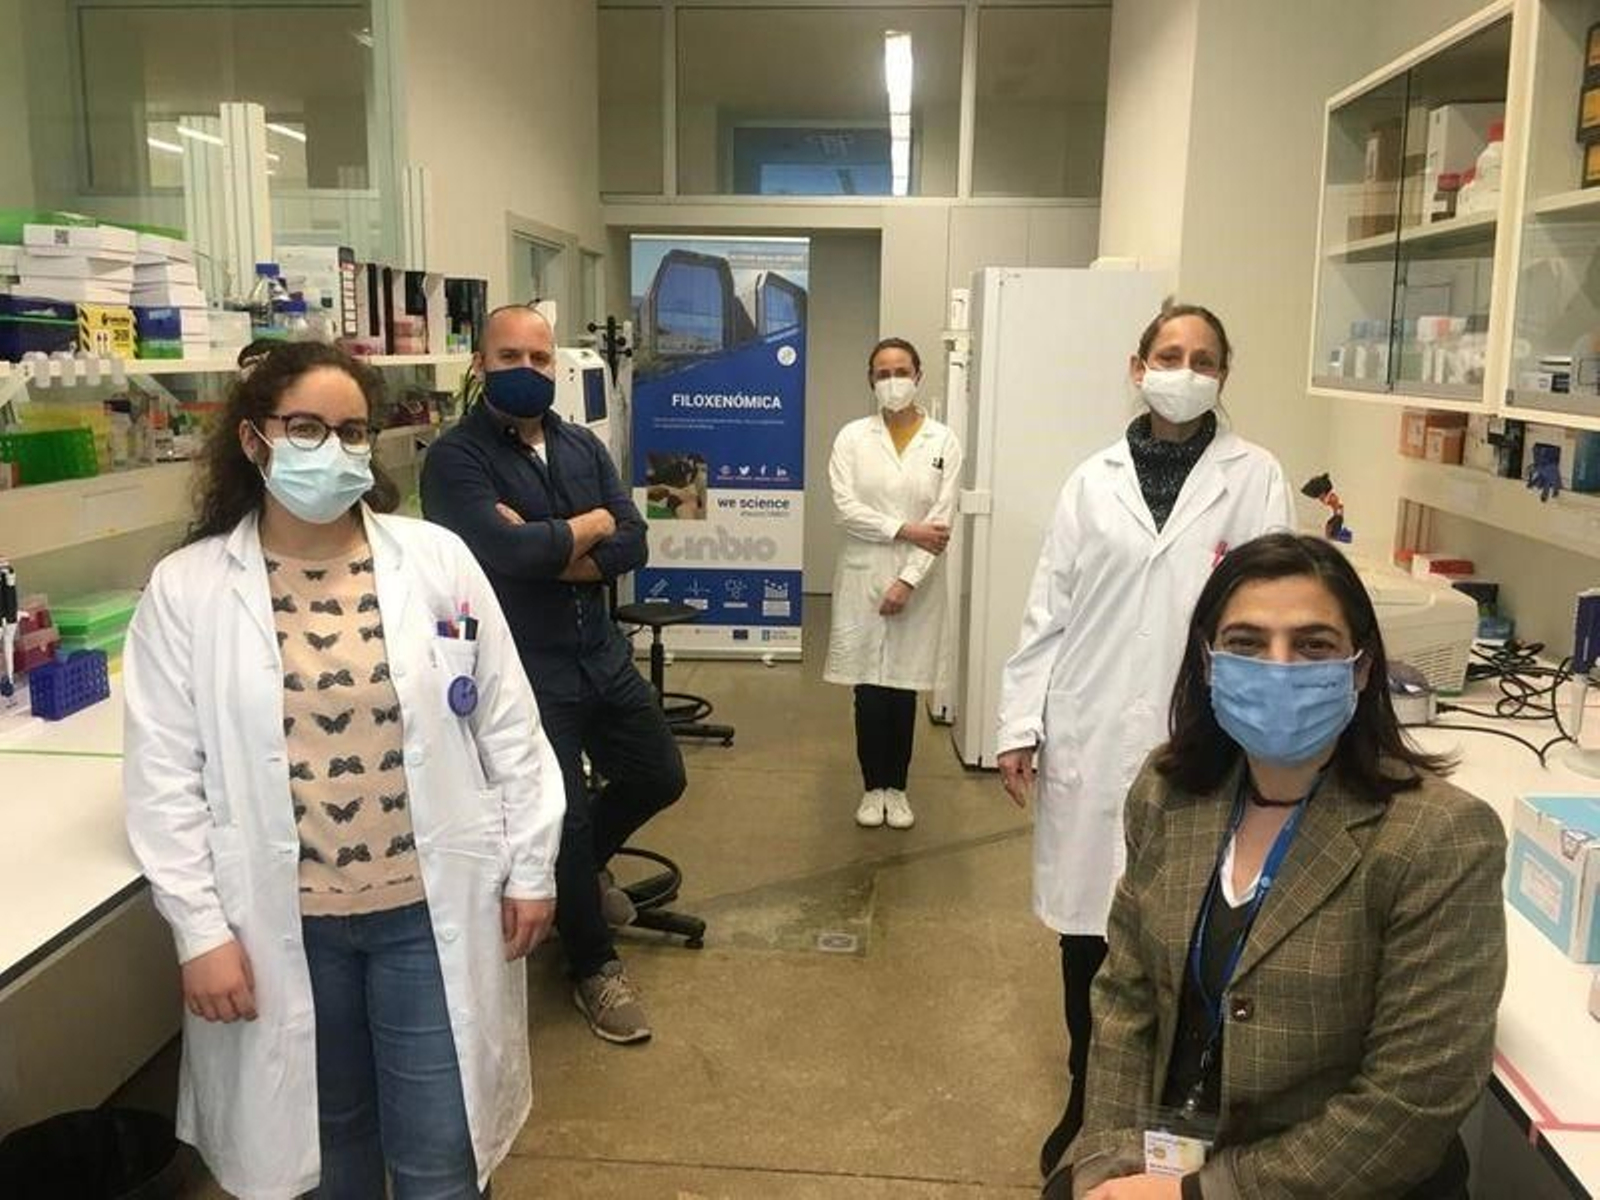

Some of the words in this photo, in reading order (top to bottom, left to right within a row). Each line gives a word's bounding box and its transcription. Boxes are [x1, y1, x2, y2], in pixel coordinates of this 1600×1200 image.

[672, 393, 782, 409] FILOXENÓMICA
[717, 498, 736, 509] we
[740, 496, 790, 509] science
